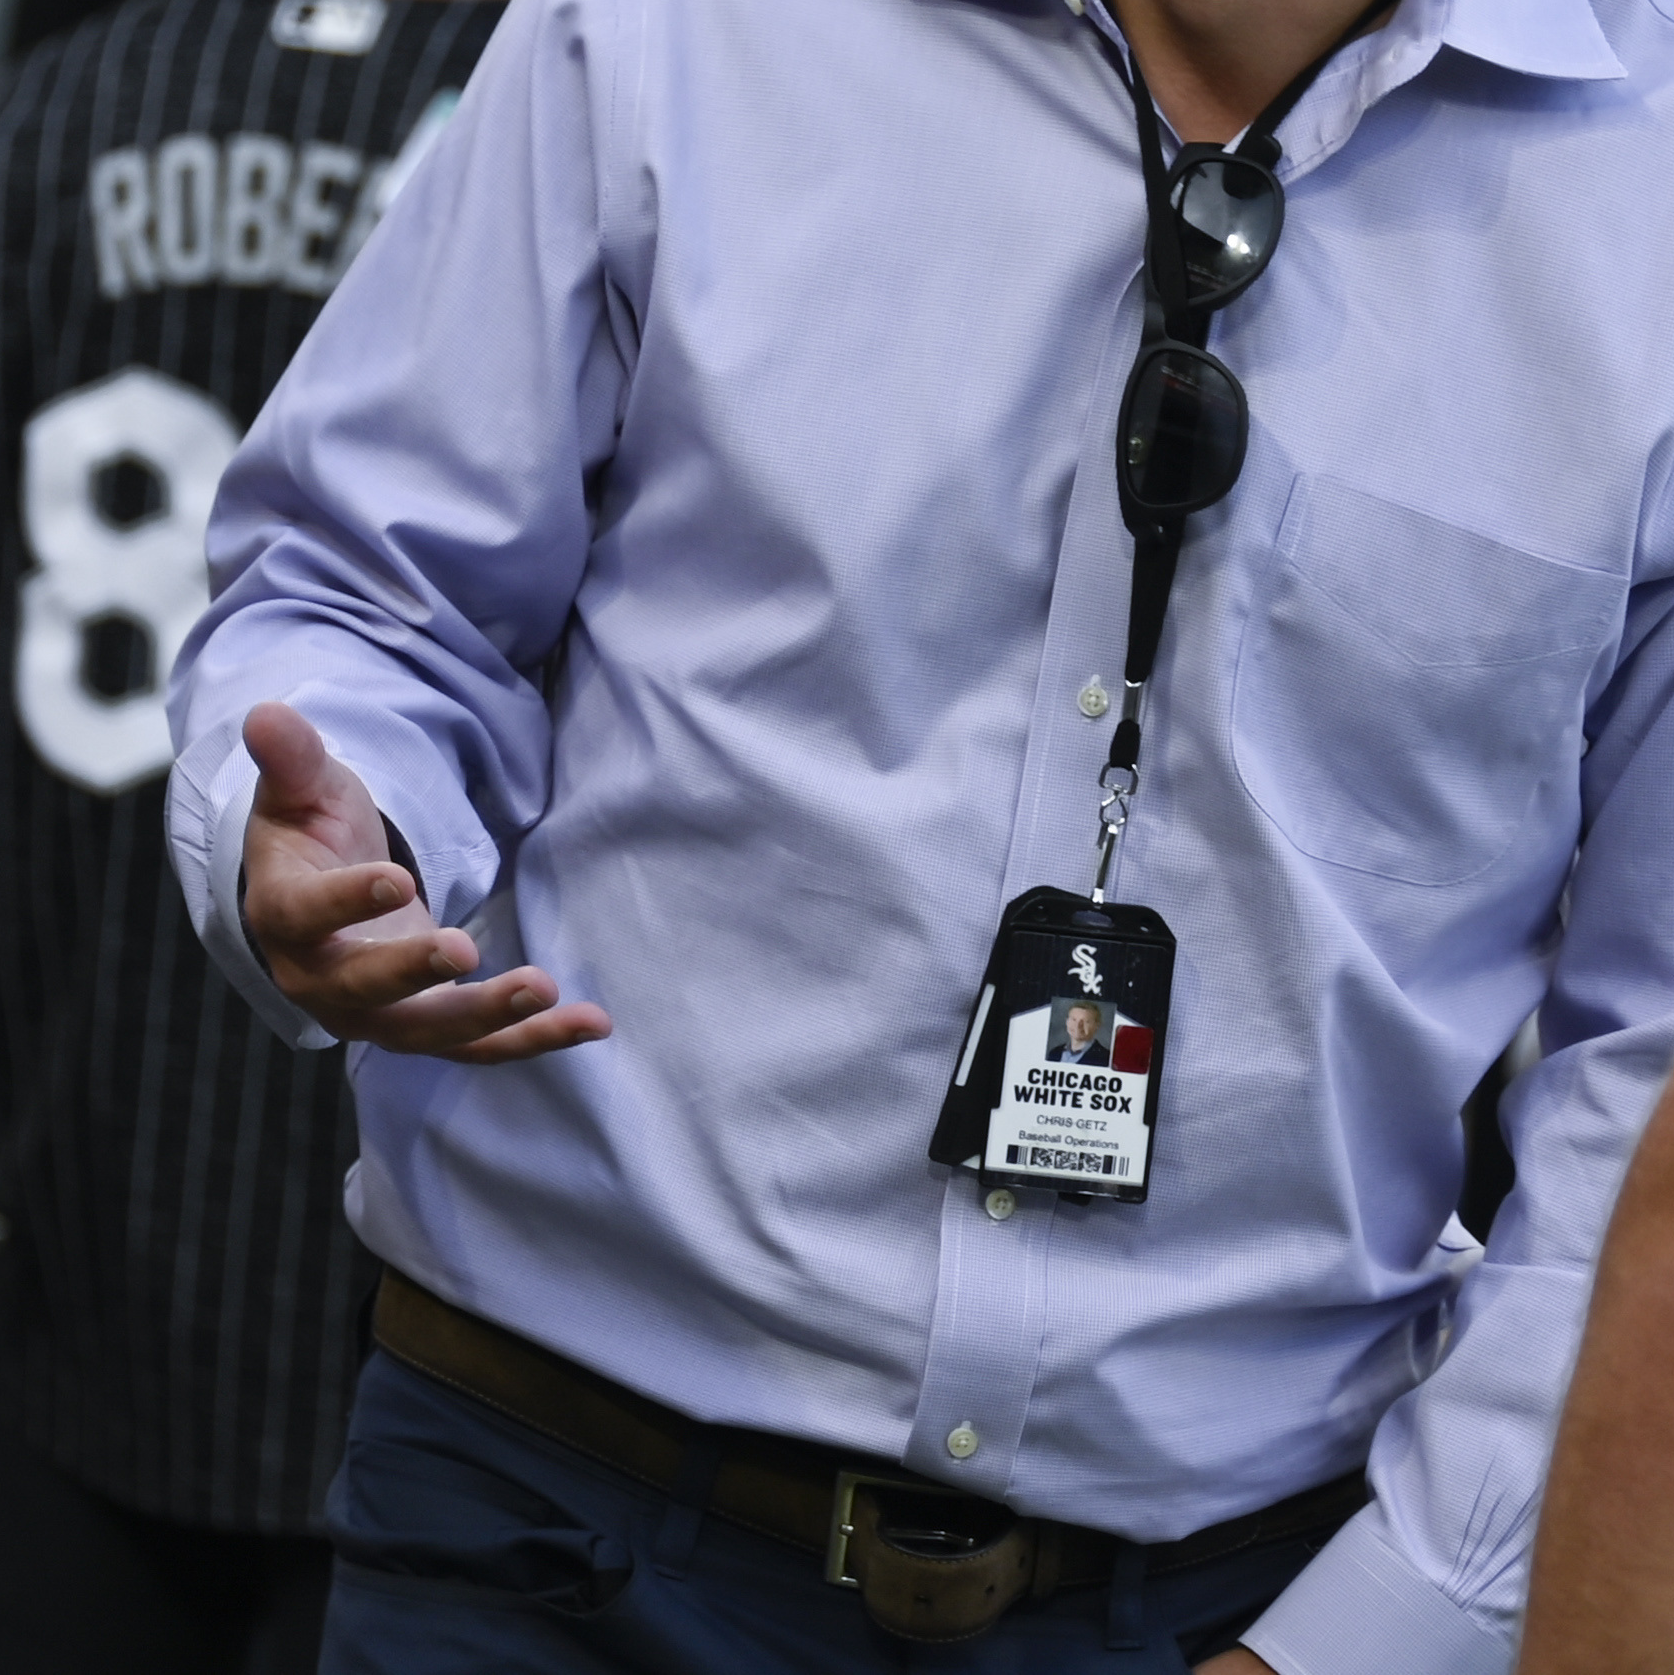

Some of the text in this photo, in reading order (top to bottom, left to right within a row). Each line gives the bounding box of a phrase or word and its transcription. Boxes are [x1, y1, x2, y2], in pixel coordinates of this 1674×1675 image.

[1027, 1068, 1123, 1093] CHICAGO
[1014, 1084, 1133, 1114] WHITE SOX
[1036, 1114, 1108, 1132] CHRIS GETZ
[1018, 1129, 1119, 1150] Baseball Operations
